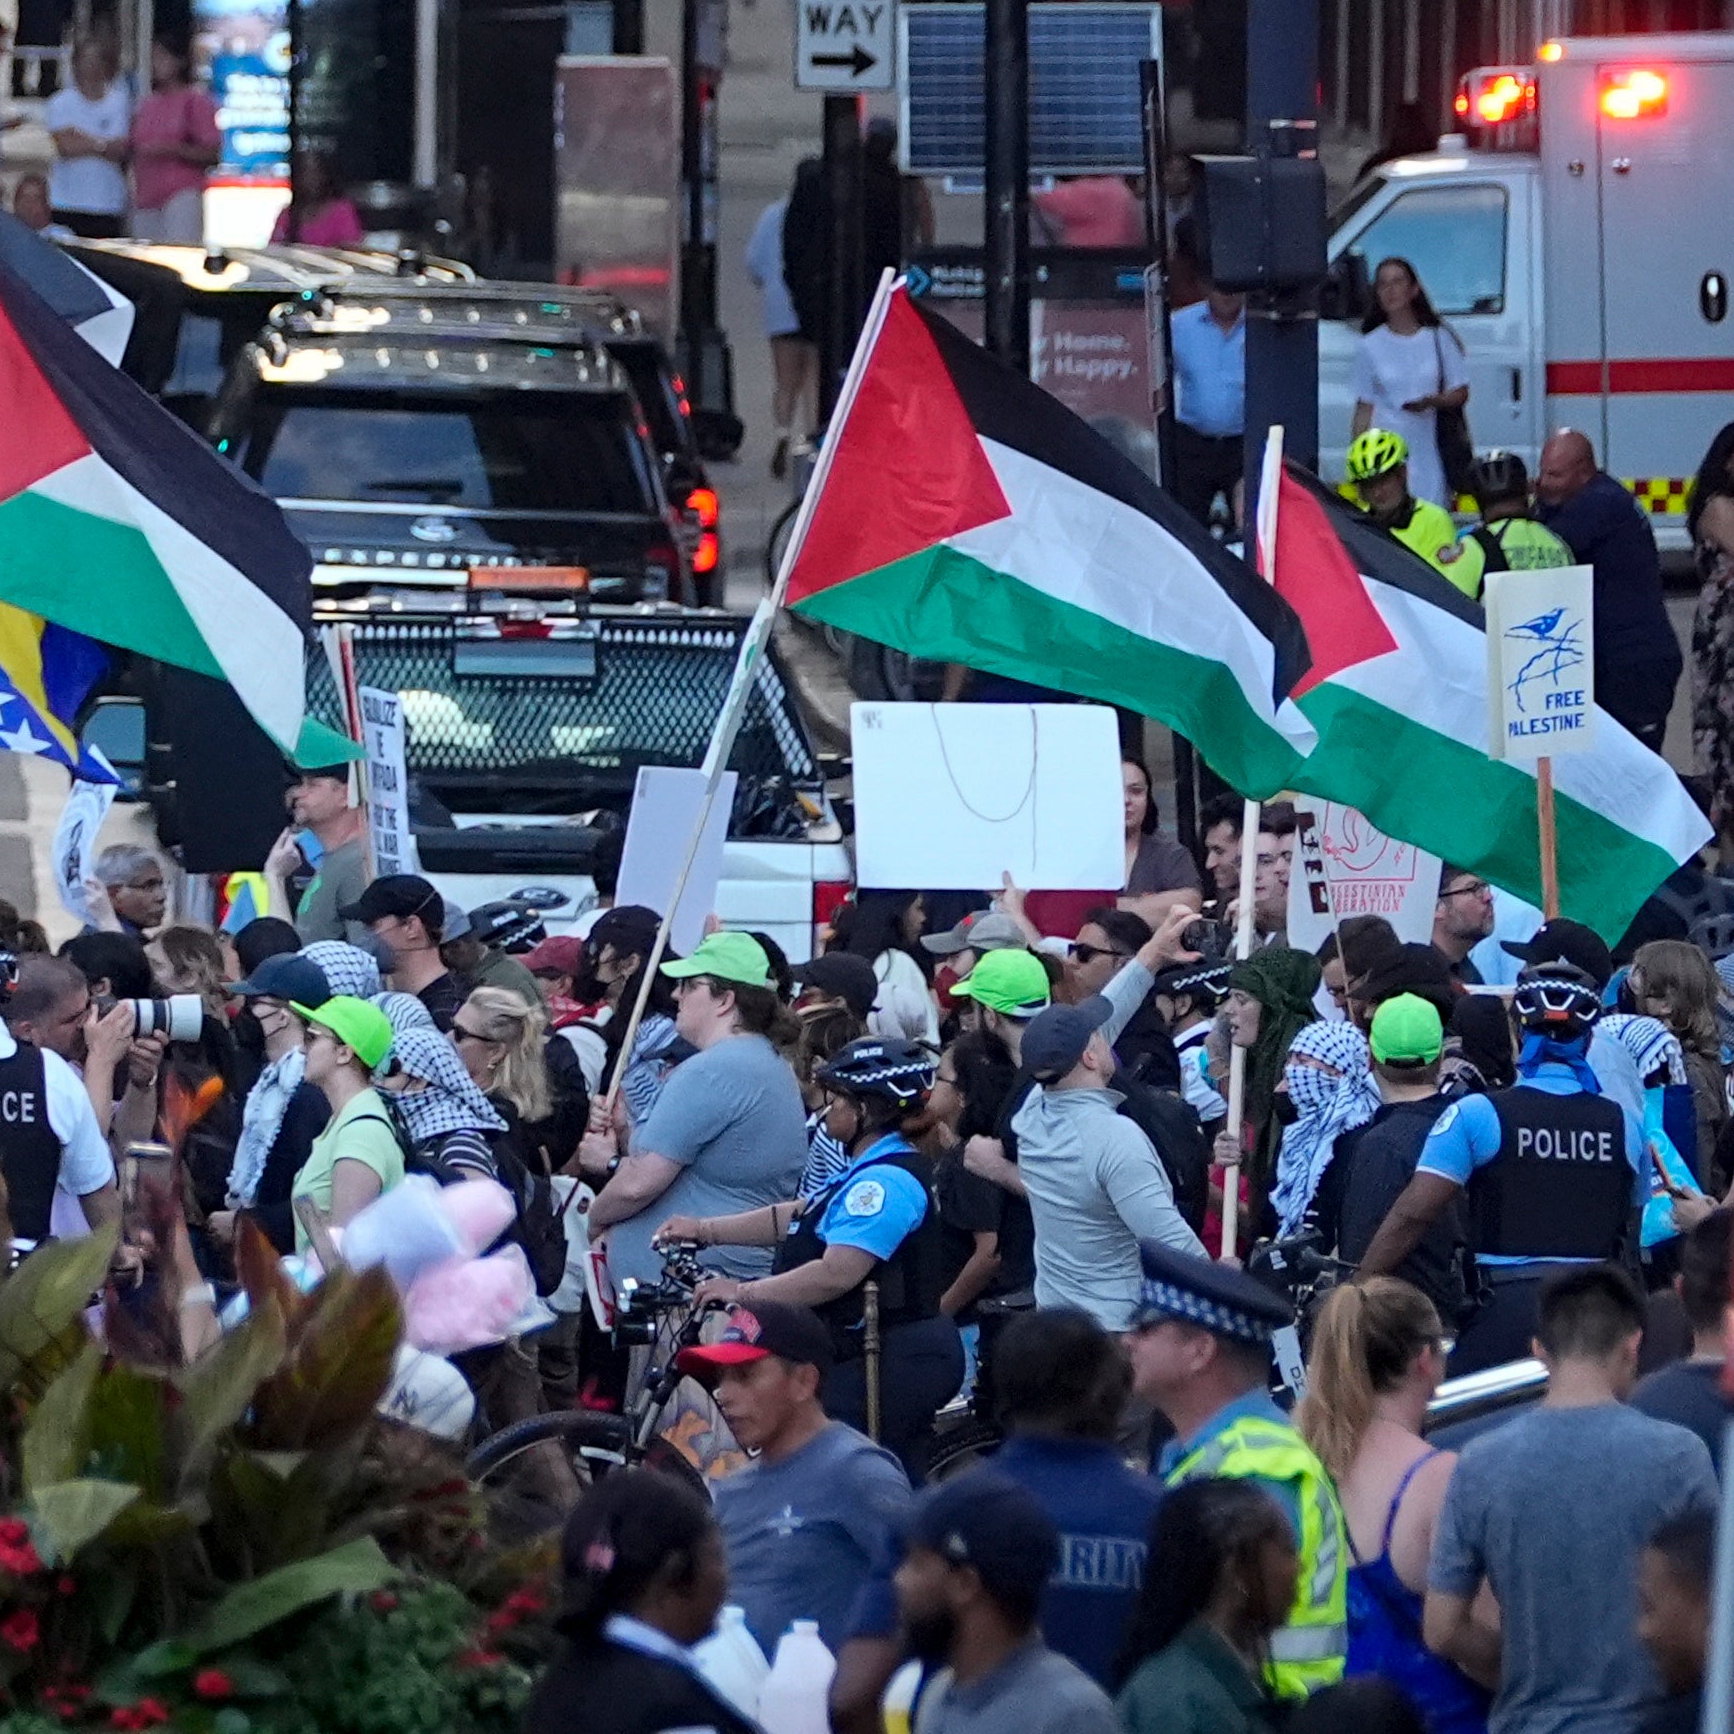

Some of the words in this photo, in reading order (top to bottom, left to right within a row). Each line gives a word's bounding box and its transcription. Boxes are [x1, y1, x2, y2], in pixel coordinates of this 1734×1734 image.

[806, 4, 884, 37] WAY
[1545, 690, 1585, 710] FREE
[1508, 713, 1585, 737] PALESTINE
[853, 1047, 884, 1060] POLICE
[1517, 1127, 1614, 1162] POLICE
